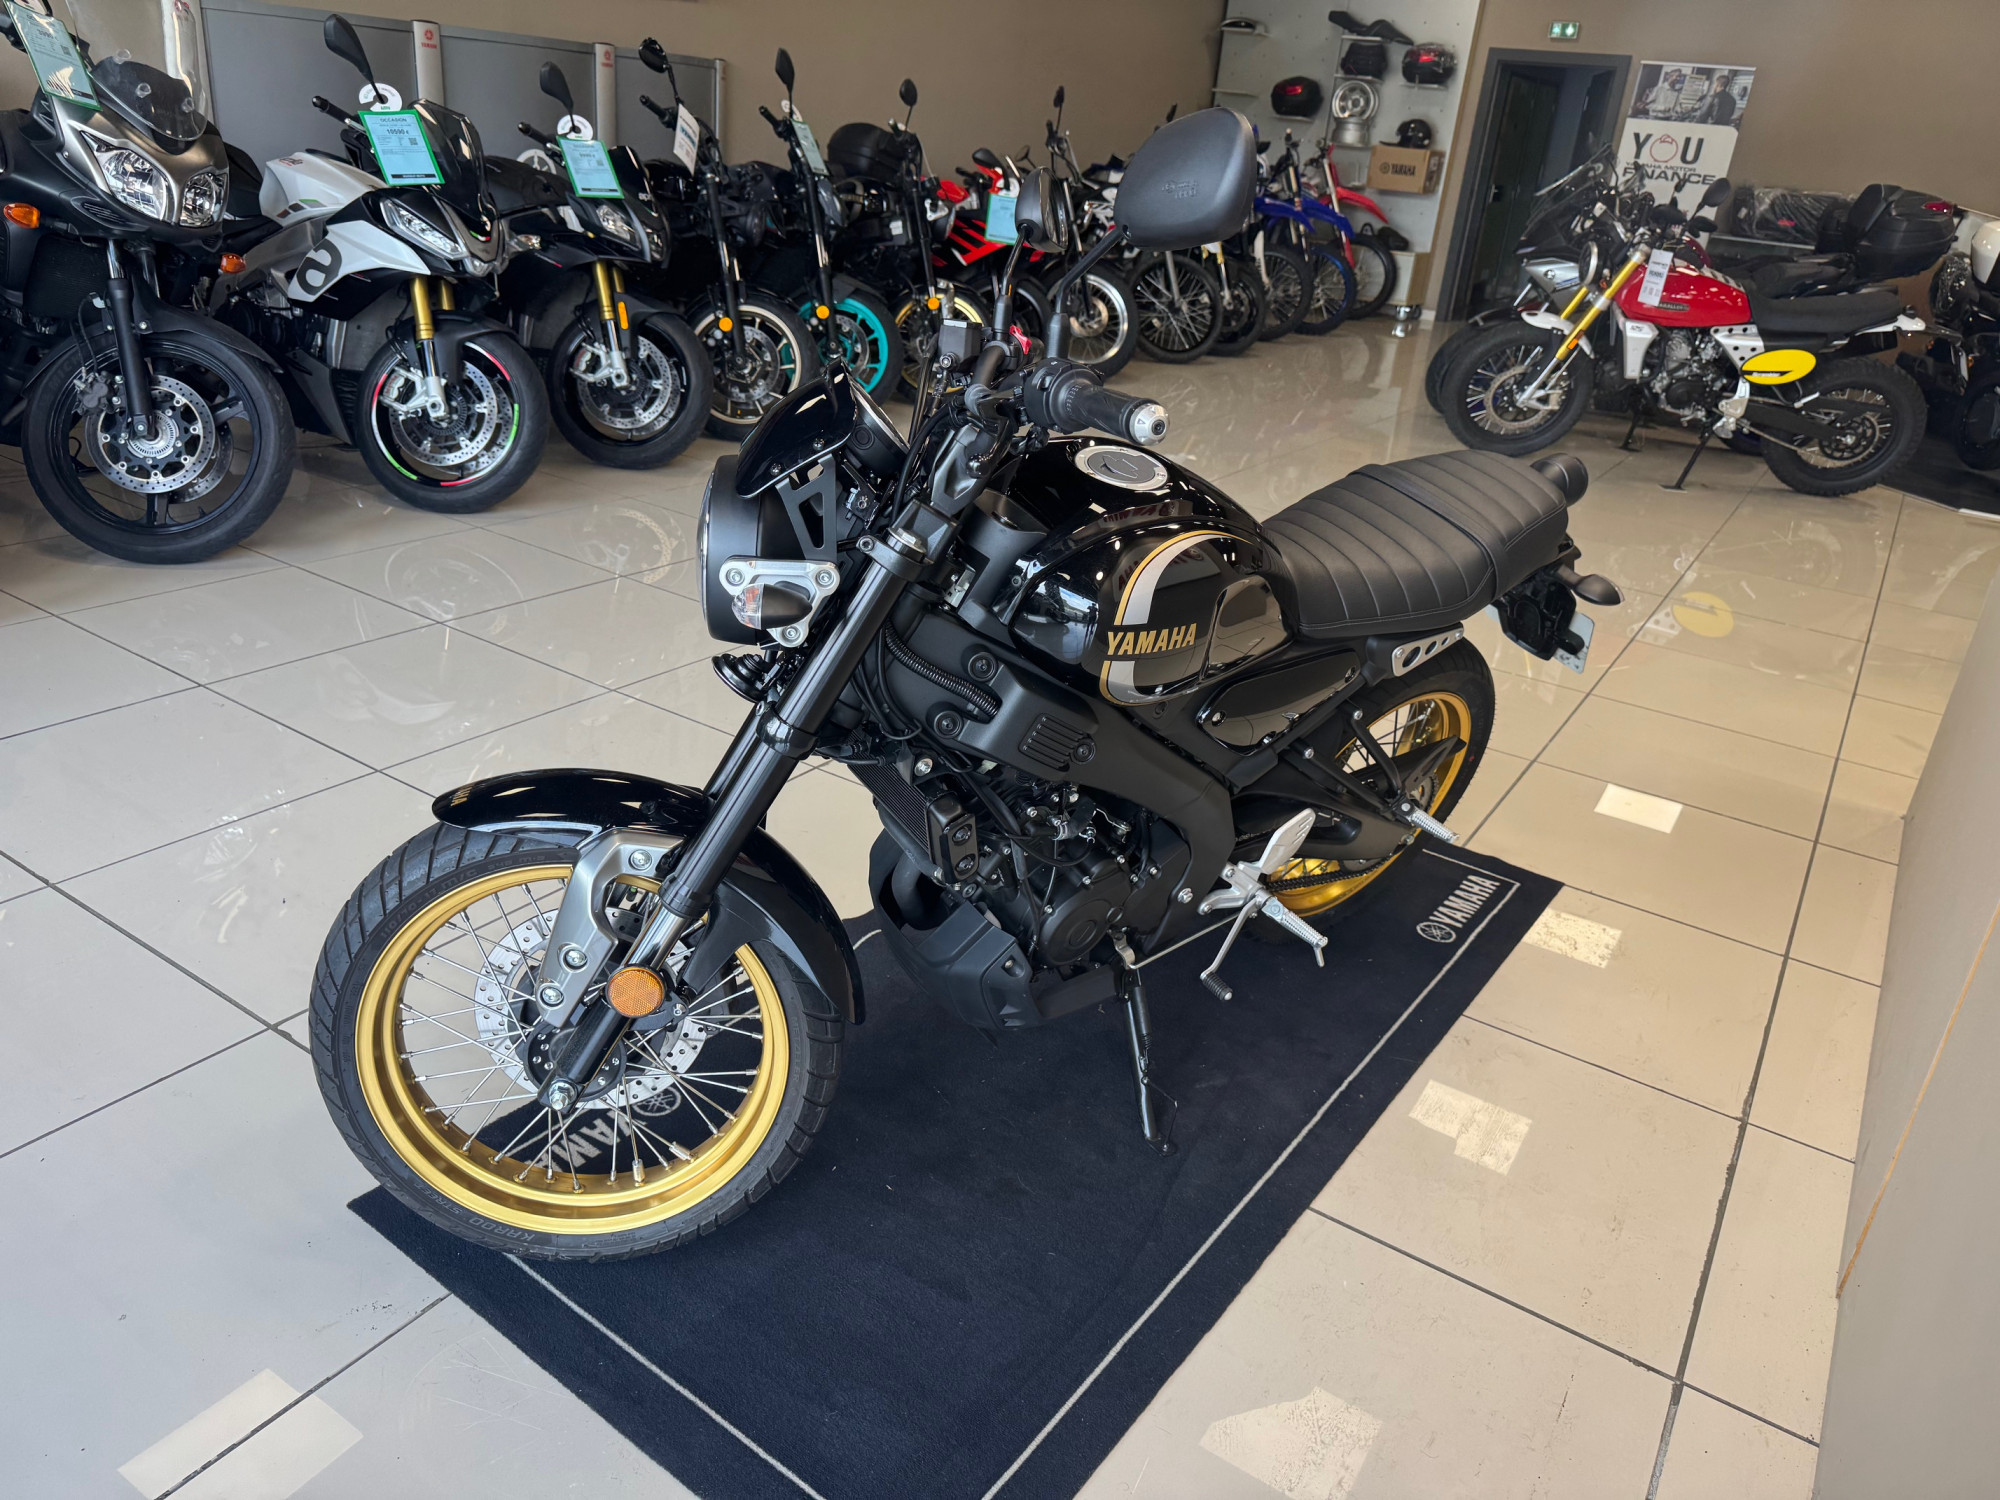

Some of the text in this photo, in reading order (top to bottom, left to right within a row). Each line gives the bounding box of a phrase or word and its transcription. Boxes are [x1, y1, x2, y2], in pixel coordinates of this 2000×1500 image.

[1622, 166, 1716, 185] FNANCE
[1664, 165, 1697, 173] MOTOR
[1107, 623, 1197, 656] YAMAHA
[1429, 875, 1501, 928] YAMAHA
[413, 1182, 536, 1242] KAROO STREET
